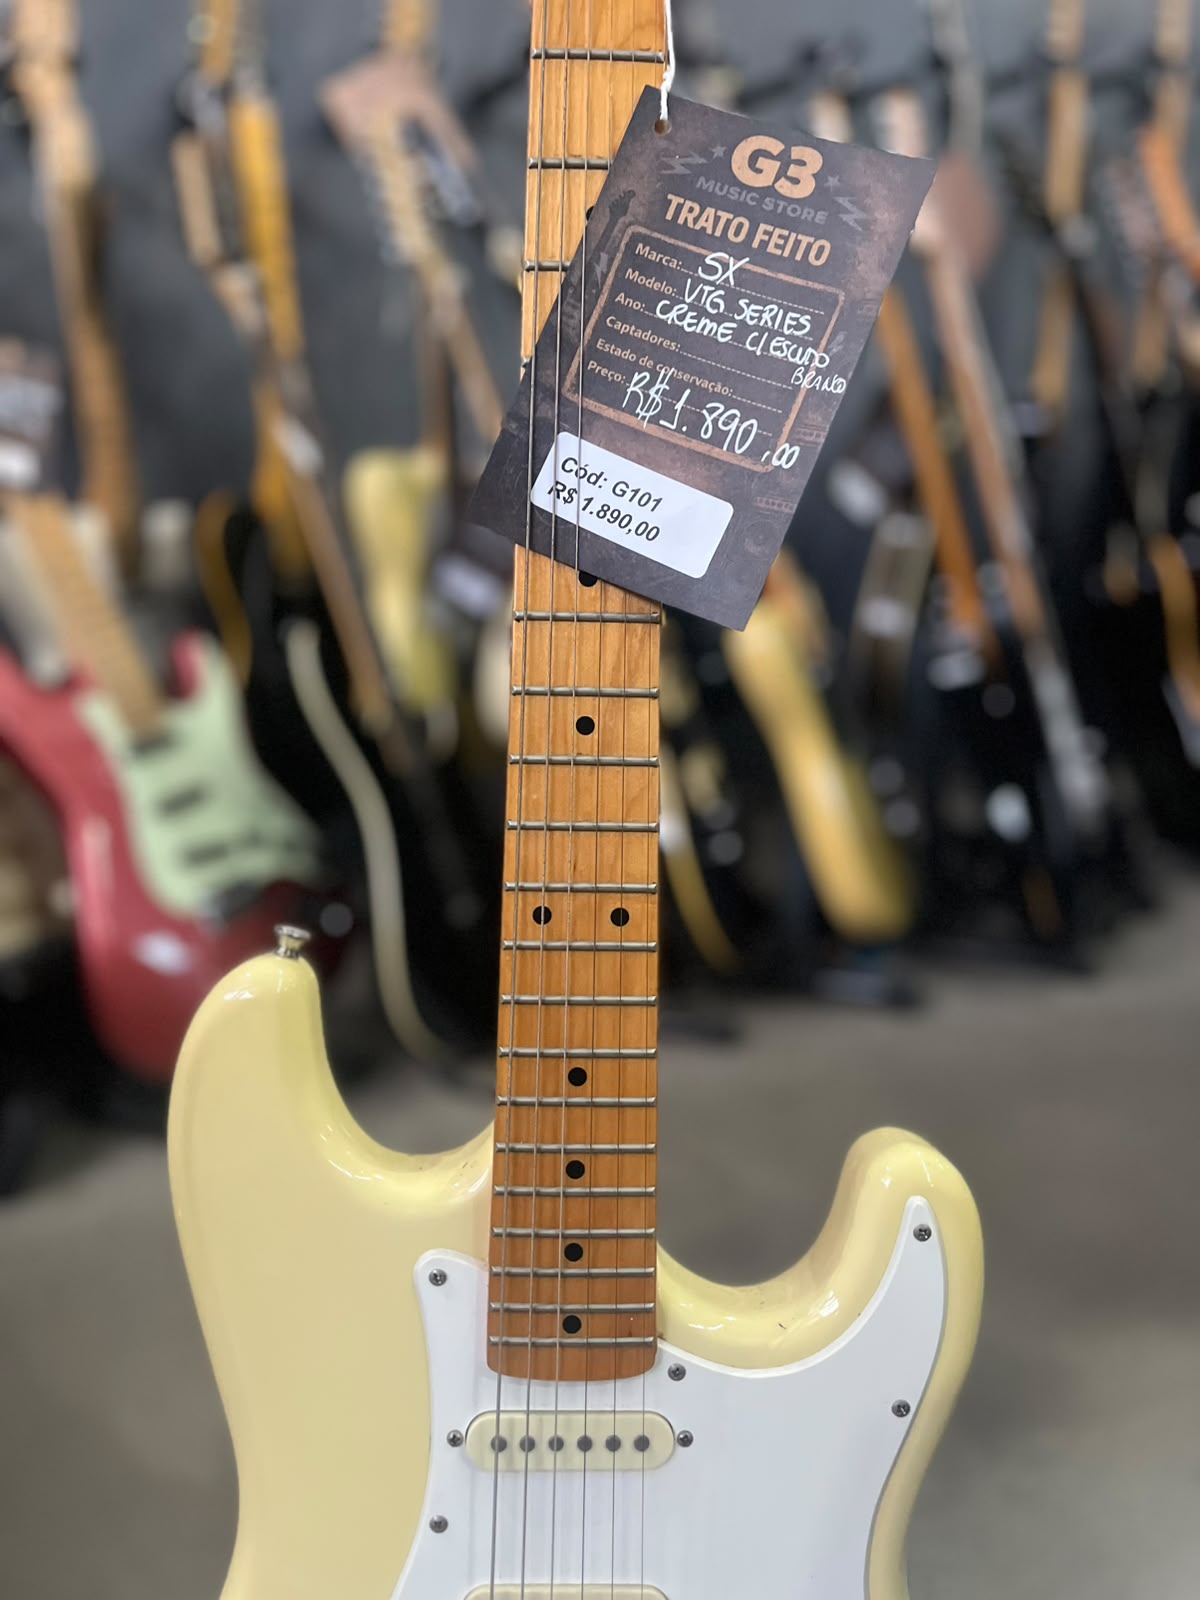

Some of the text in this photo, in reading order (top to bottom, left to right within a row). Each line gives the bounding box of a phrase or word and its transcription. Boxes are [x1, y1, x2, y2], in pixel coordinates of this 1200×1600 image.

[731, 135, 823, 199] G3
[696, 176, 828, 225] MUSIC STORE
[664, 193, 831, 267] TRATO FEITO
[635, 243, 682, 271] Marca:
[698, 252, 750, 286] SX
[615, 291, 646, 312] Ano:
[624, 267, 677, 297] Modelo:
[684, 278, 812, 336] VTG SERIES
[605, 315, 682, 352] Captadores:
[587, 360, 626, 384] Preço:
[596, 338, 733, 398] Estado de conservação:
[560, 457, 663, 512] Cód: G101
[547, 480, 661, 542] R$ 1.890,00
